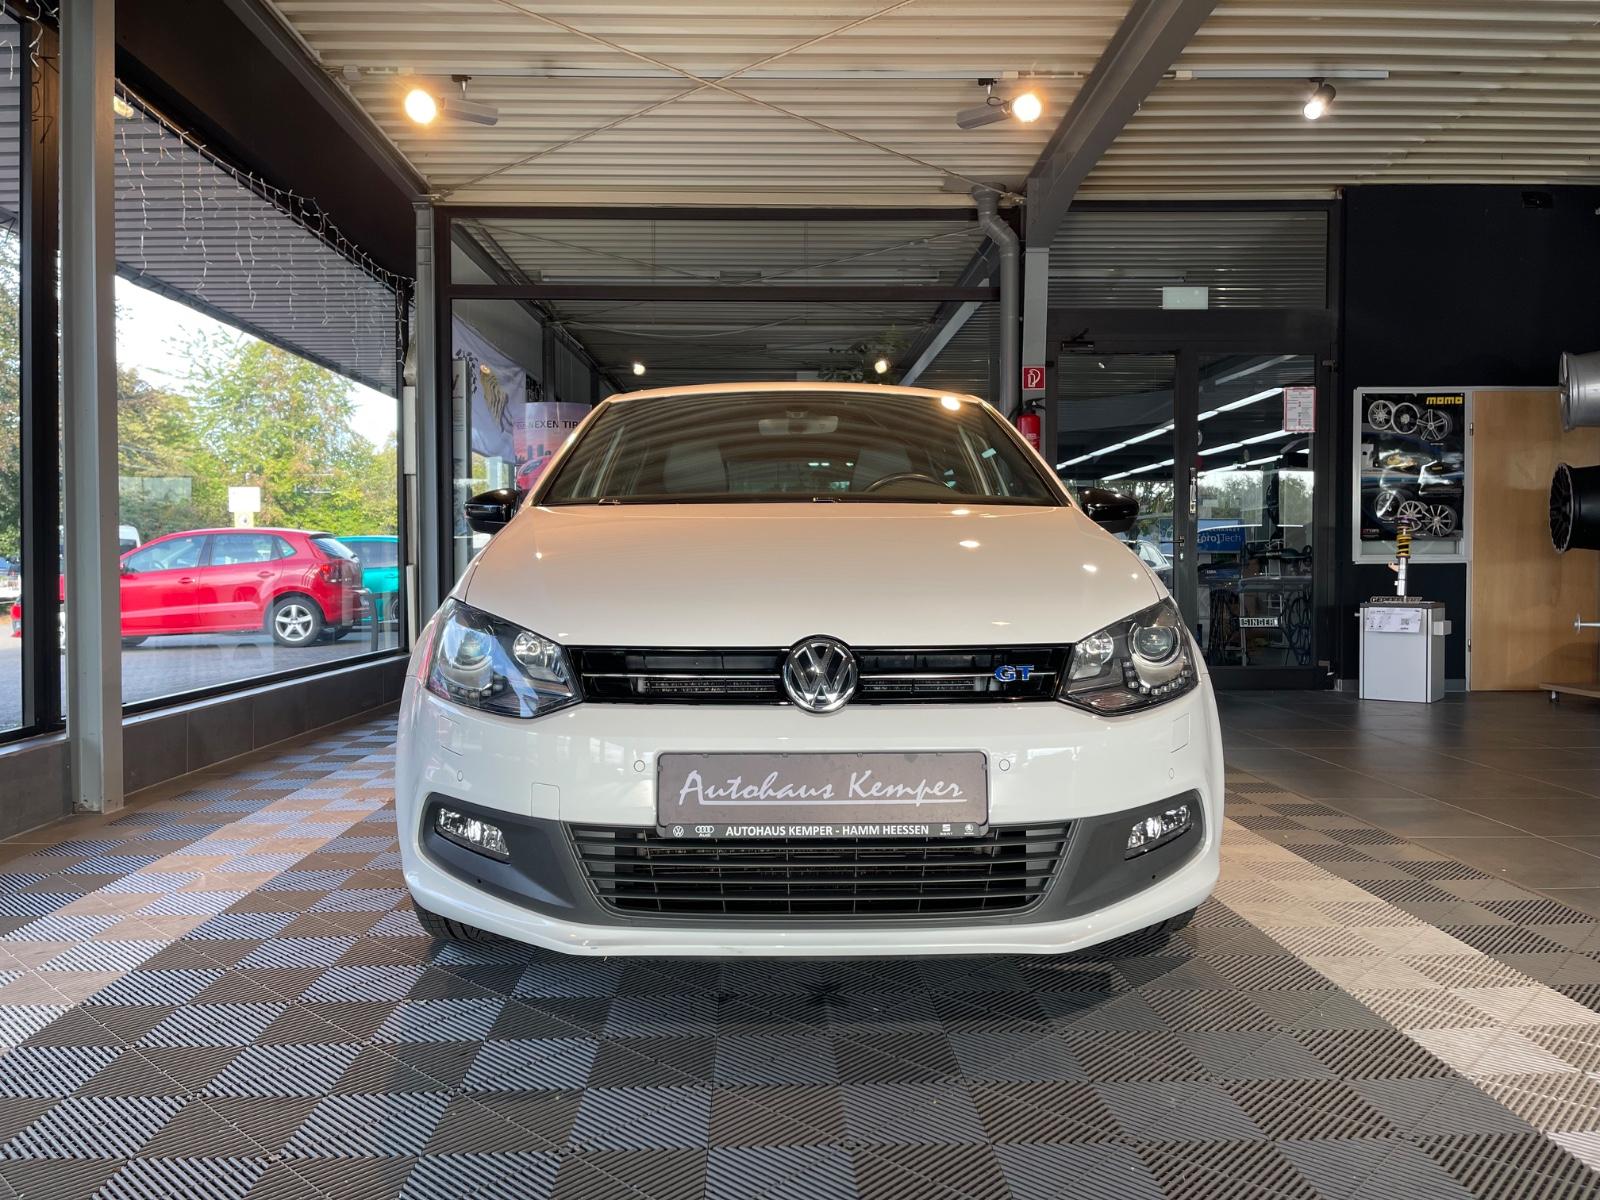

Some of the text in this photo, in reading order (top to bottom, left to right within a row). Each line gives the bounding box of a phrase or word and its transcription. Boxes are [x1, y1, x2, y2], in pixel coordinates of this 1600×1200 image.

[1426, 396, 1463, 405] momo
[528, 420, 559, 429] NEXEN
[994, 664, 1035, 682] GT
[679, 770, 963, 807] Autohaus Kemper
[725, 825, 789, 837] AUTOHAUS
[789, 825, 833, 837] KEMPER
[842, 825, 880, 836] HAMM
[882, 825, 929, 836] HEESSEN
